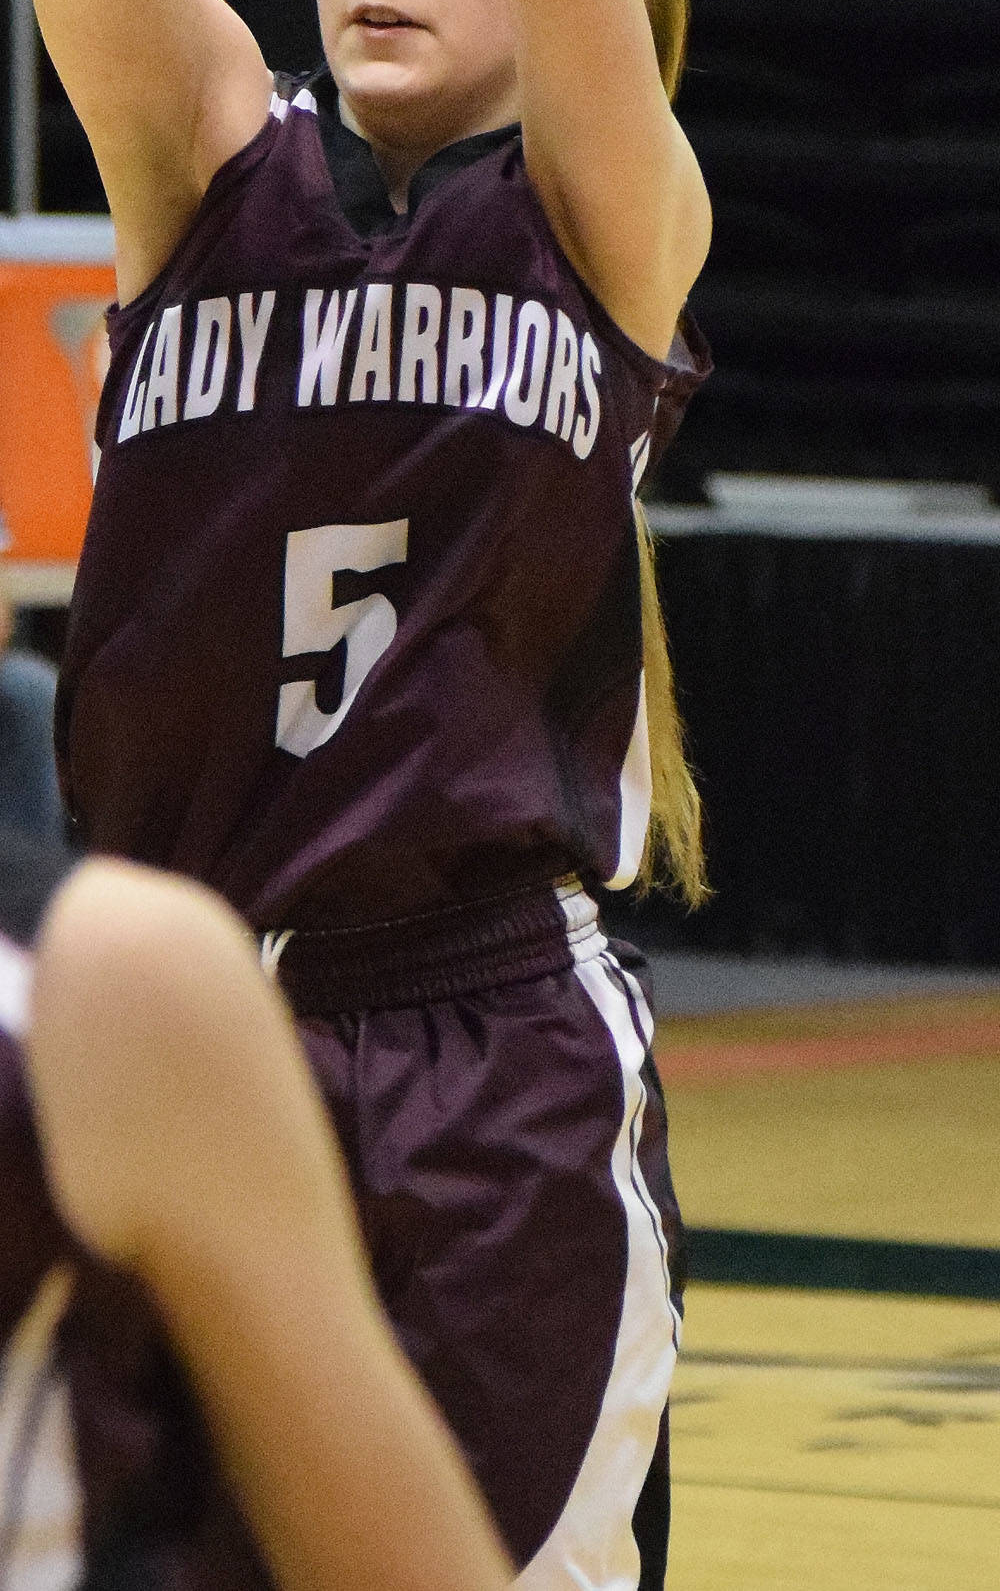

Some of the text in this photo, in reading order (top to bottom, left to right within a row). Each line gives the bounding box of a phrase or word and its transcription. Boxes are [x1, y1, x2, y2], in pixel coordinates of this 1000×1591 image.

[118, 283, 601, 460] LADY WARRIORS
[275, 518, 409, 760] 5
